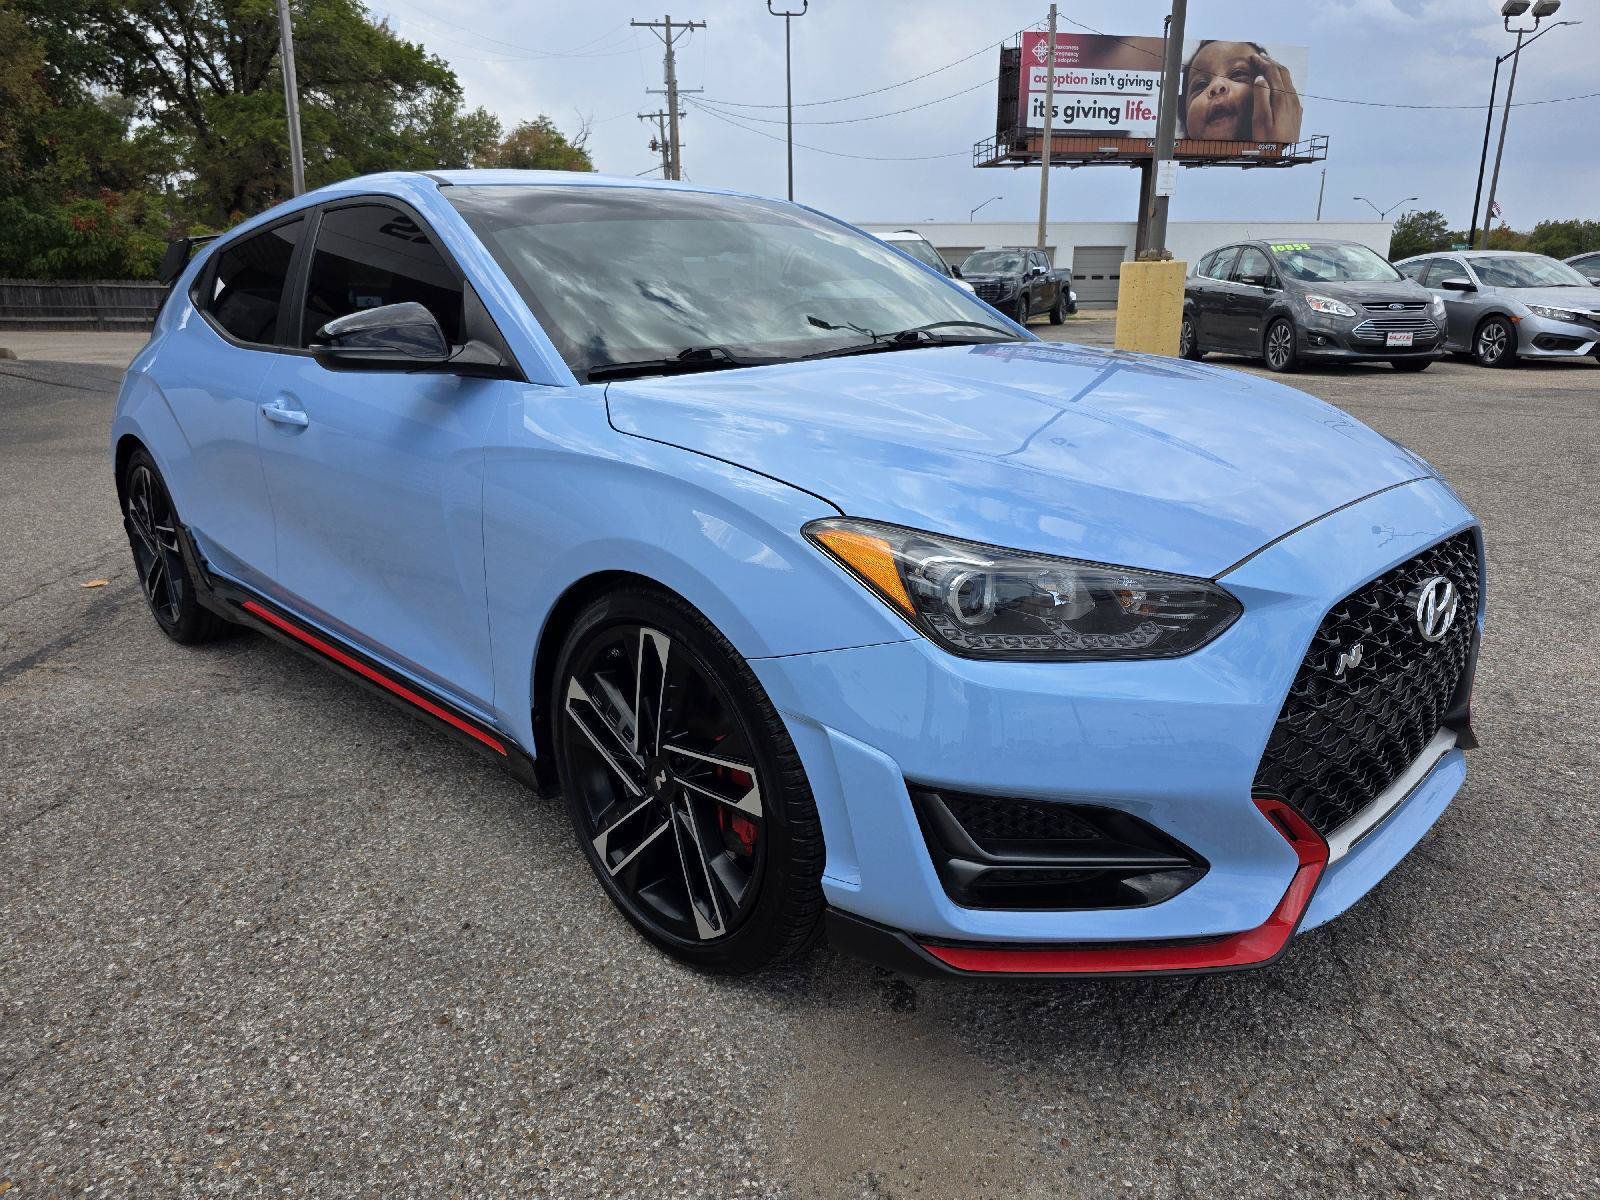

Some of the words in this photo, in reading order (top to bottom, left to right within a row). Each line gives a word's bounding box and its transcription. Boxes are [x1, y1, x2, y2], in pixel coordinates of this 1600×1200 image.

[1091, 73, 1115, 86] isn't
[1117, 74, 1153, 91] giving
[1033, 97, 1059, 118] its
[1063, 99, 1121, 126] giving
[1125, 100, 1157, 121] life.
